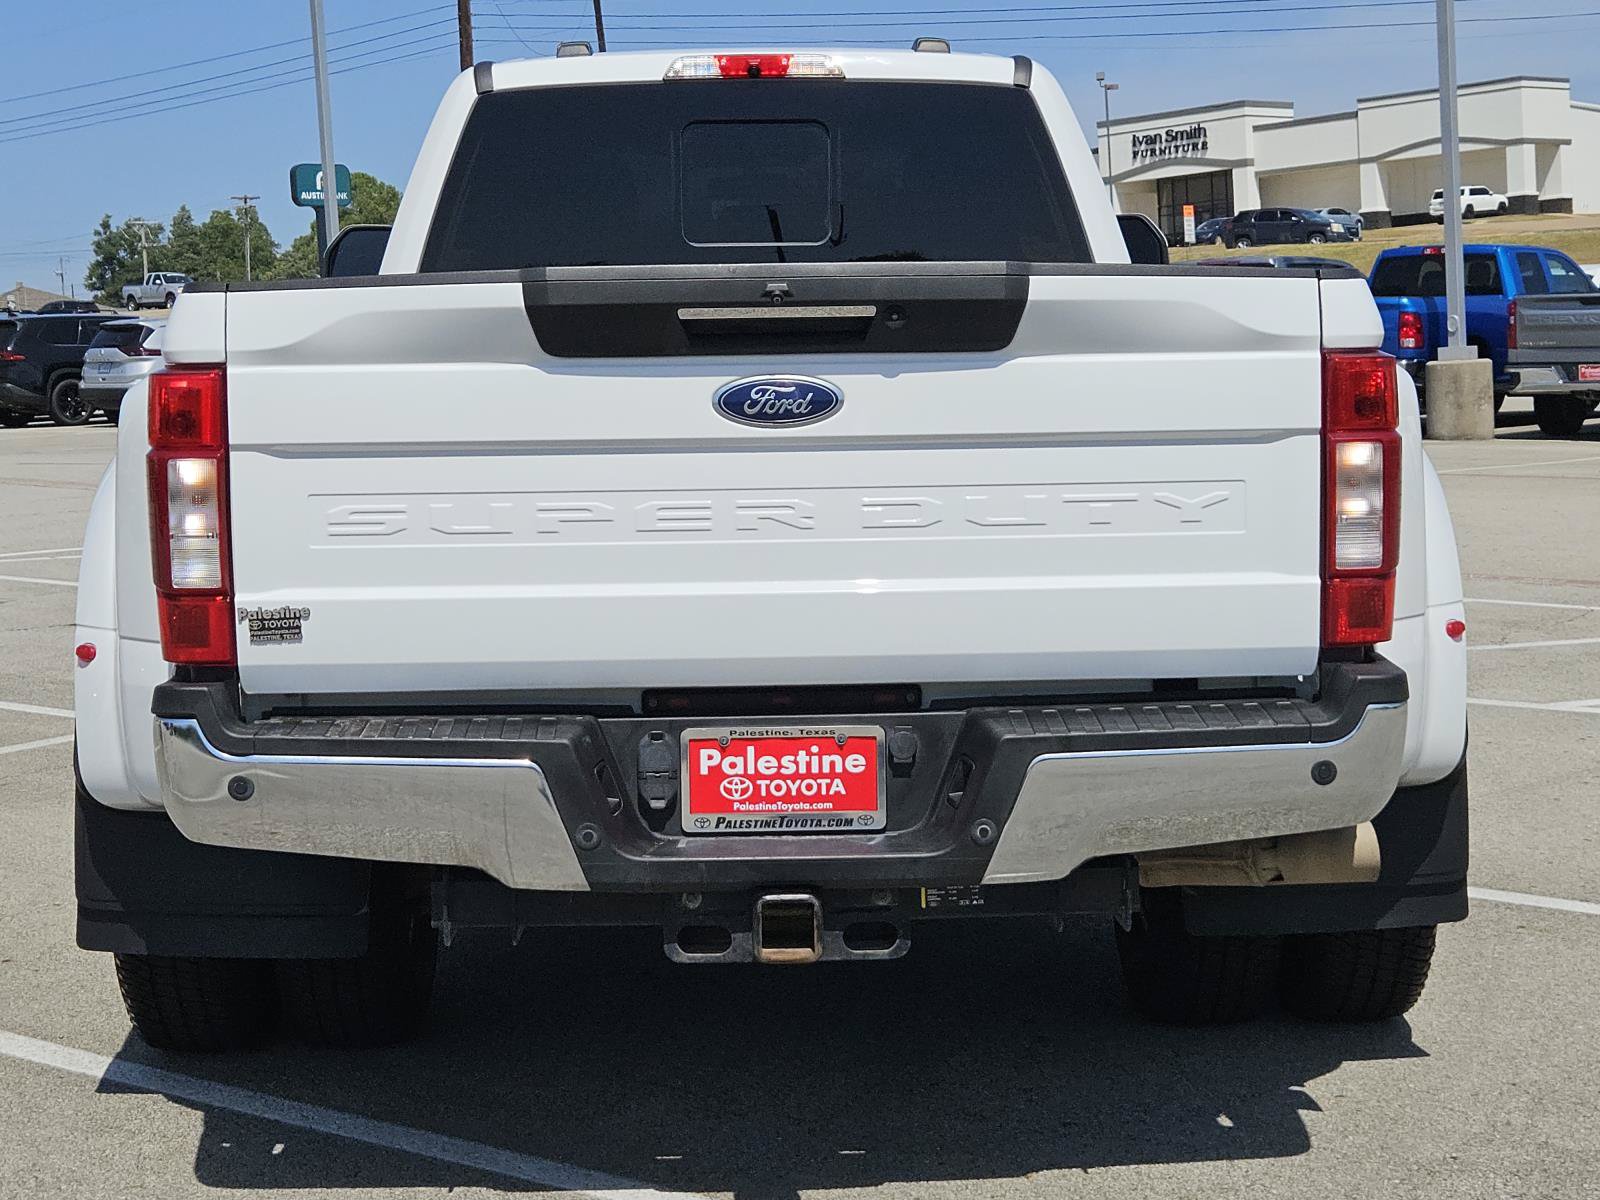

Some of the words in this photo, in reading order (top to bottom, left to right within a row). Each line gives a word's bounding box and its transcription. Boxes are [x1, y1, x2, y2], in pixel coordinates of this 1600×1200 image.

[1132, 133, 1162, 147] Ivan
[1165, 123, 1207, 143] Smith
[1132, 141, 1208, 159] FURNITURE
[744, 386, 813, 415] Ford
[327, 498, 814, 536] SUPER
[861, 491, 1230, 529] DUTY
[237, 606, 310, 622] Palestine
[263, 619, 301, 628] TOYOTA
[730, 729, 793, 737] Palestine,
[698, 745, 866, 775] Palestine
[757, 779, 846, 797] TOYOTA
[733, 801, 833, 812] PalestineToyota.com
